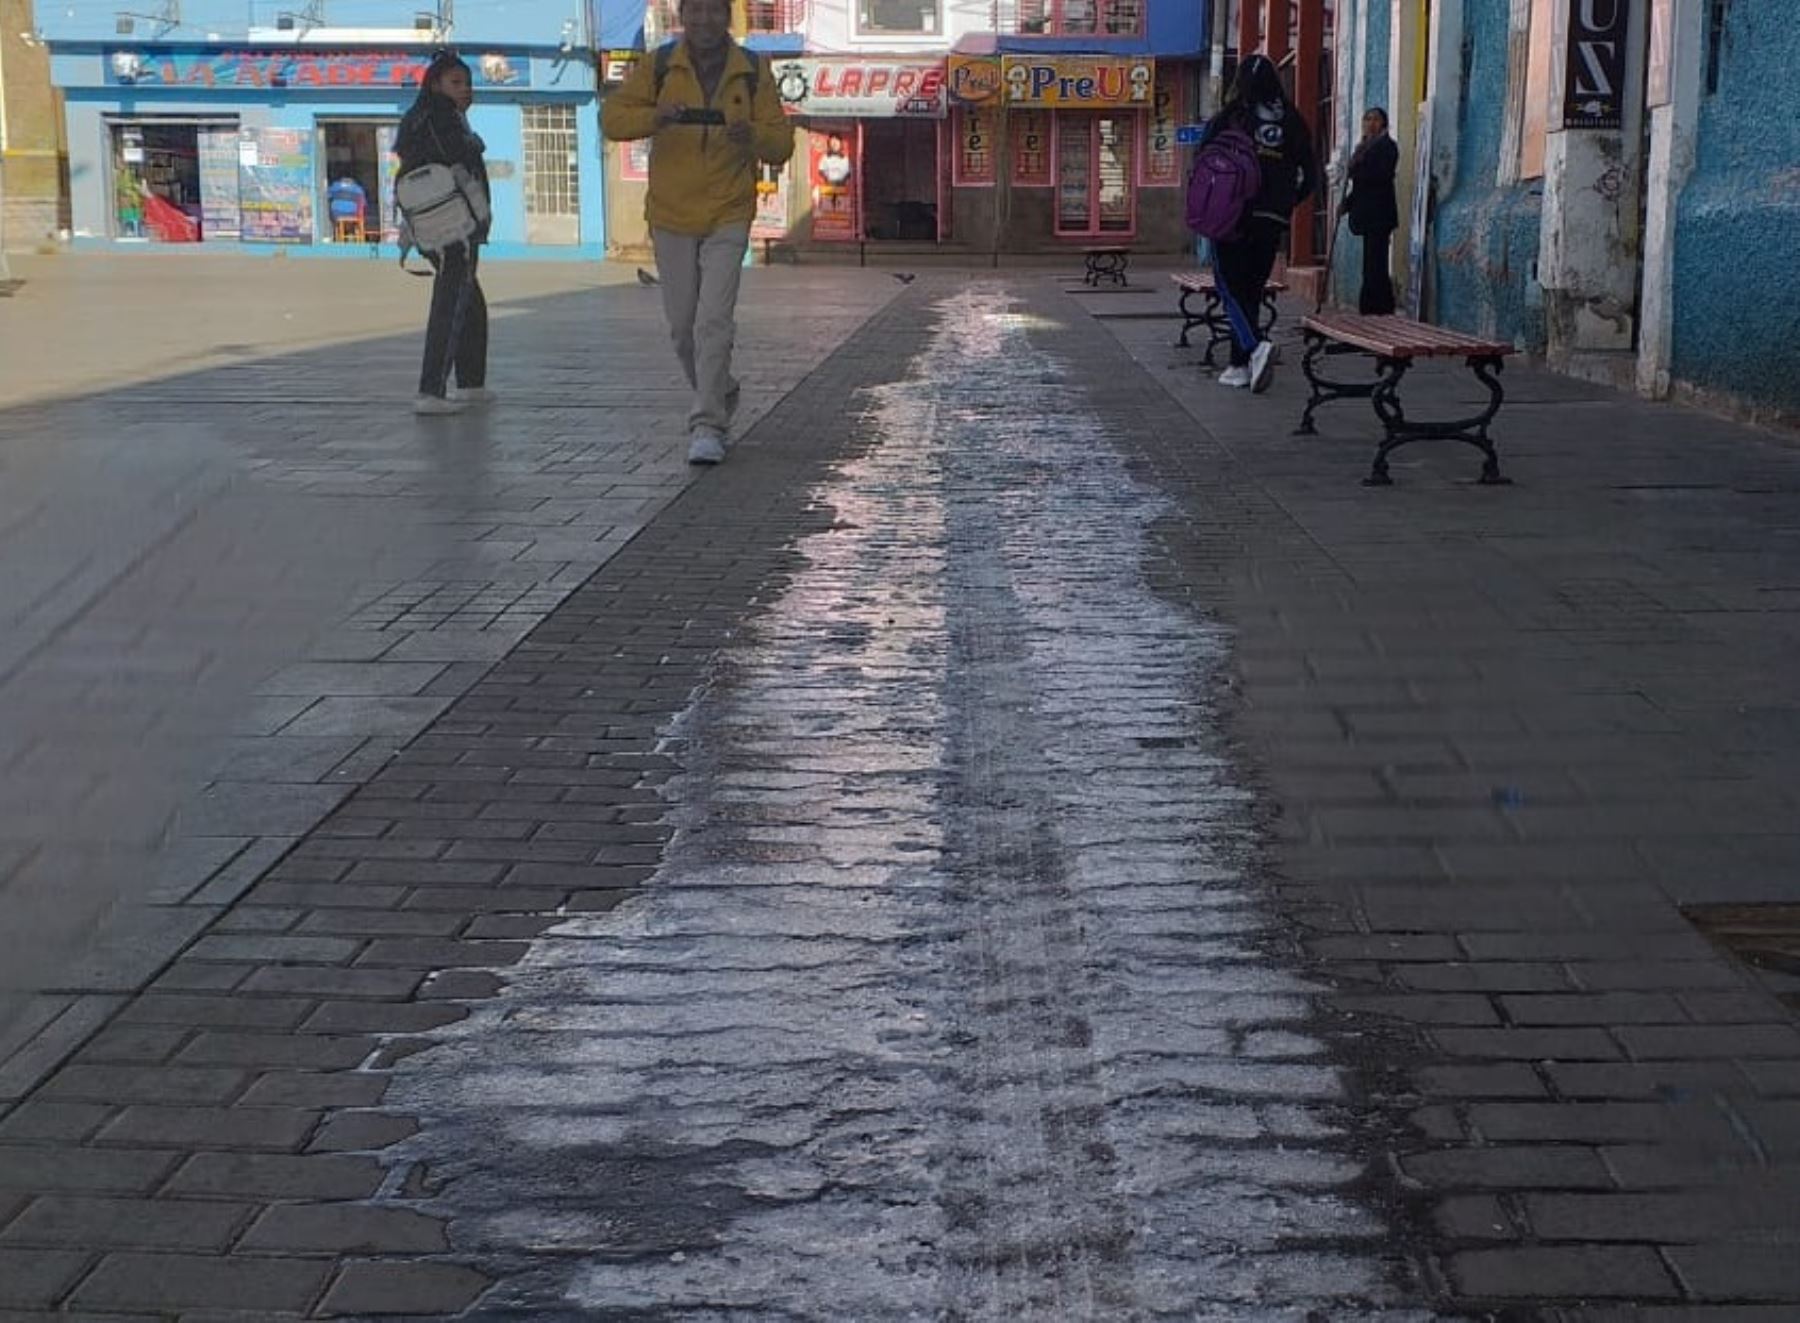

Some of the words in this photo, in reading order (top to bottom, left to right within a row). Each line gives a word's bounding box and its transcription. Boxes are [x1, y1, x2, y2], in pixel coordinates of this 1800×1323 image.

[233, 61, 428, 88] ACADEM
[813, 67, 943, 98] LAPRE
[1031, 66, 1127, 99] PreU
[1022, 112, 1042, 174] reU
